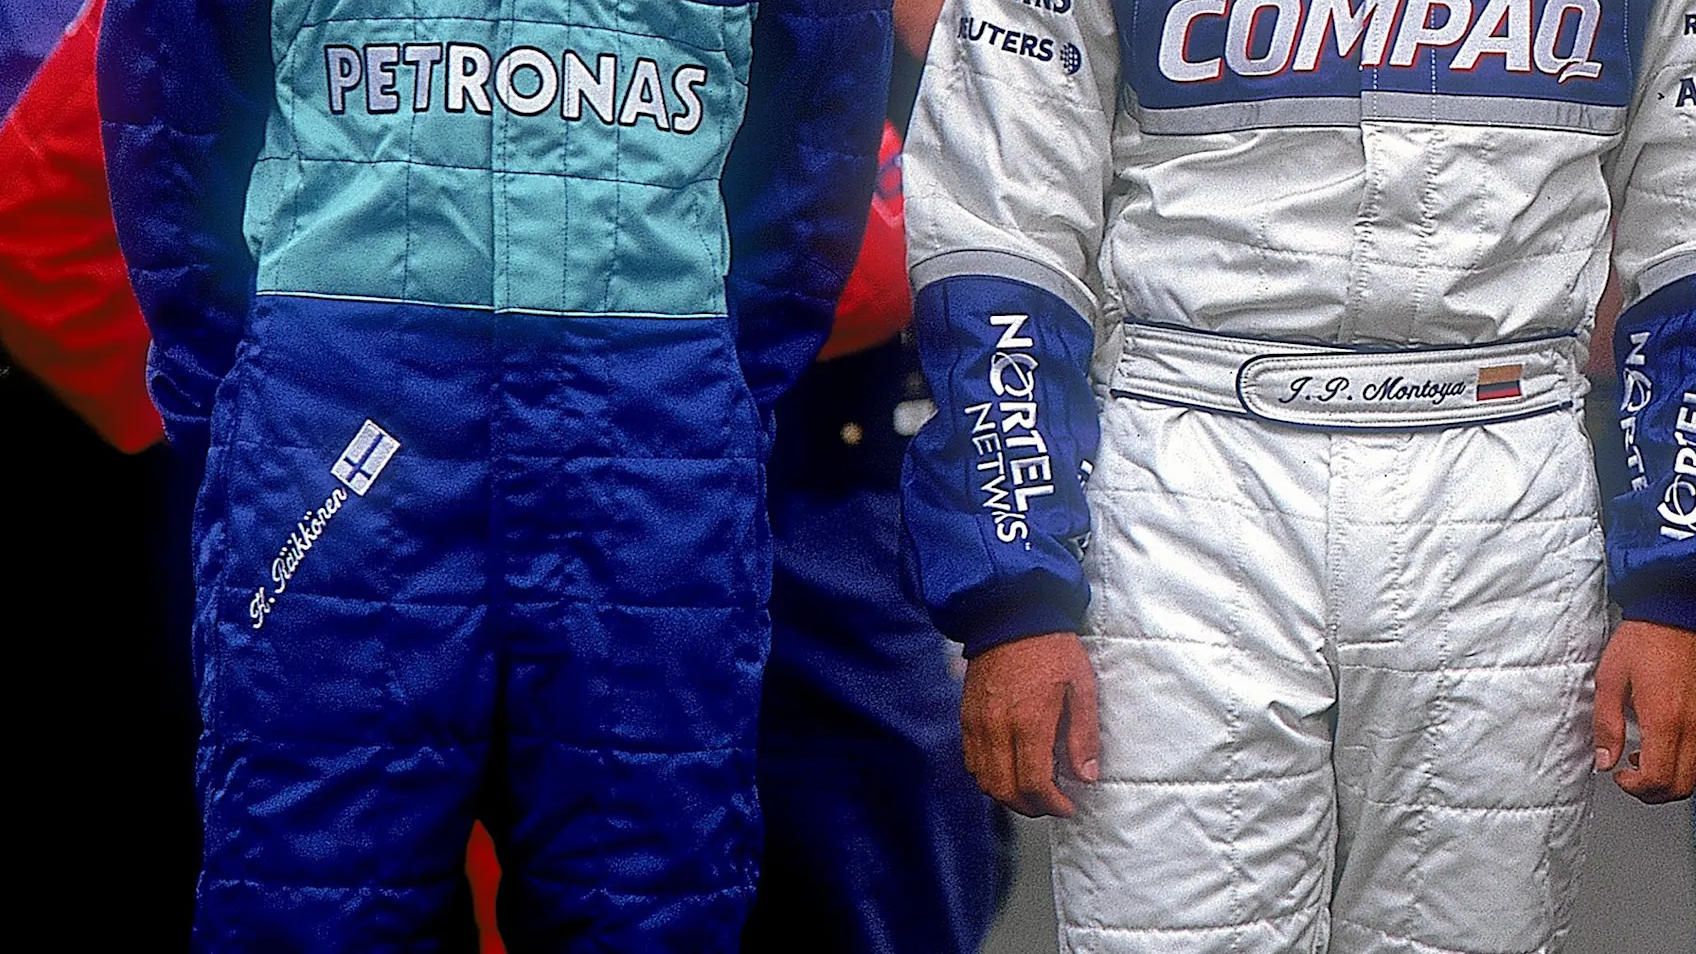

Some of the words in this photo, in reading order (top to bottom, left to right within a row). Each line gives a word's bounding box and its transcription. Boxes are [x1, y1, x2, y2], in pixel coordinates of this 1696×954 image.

[324, 42, 708, 135] PETRONAS
[989, 314, 1055, 512] NORTEL
[1317, 376, 1353, 403] P.
[1361, 376, 1466, 405] Montoya
